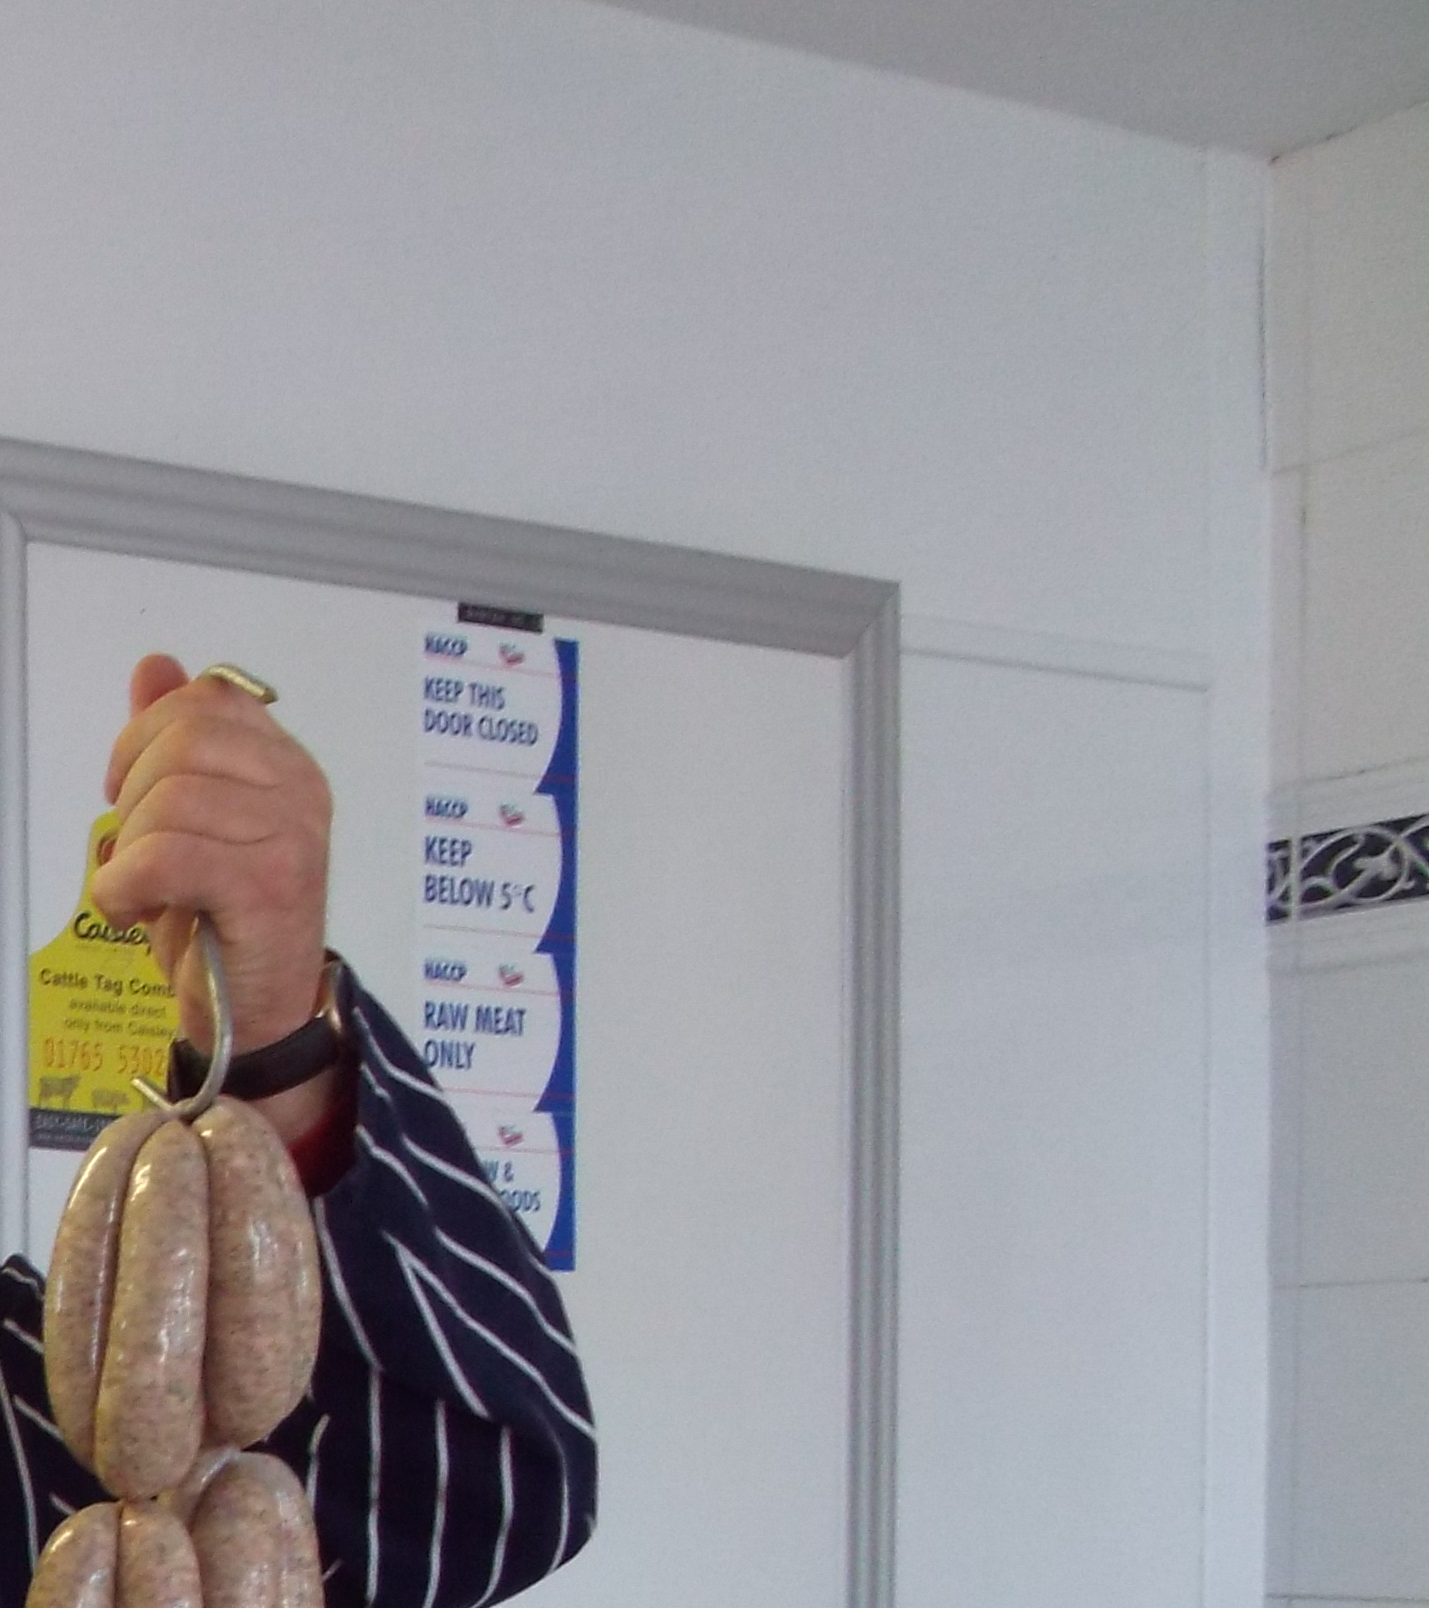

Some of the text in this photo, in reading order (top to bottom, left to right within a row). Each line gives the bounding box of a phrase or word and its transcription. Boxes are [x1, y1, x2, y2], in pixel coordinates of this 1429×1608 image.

[423, 676, 506, 711] KEEP THIS
[424, 709, 539, 747] DOOR CLOSED
[424, 835, 472, 867] KEEP
[424, 874, 495, 908] BELOW
[40, 968, 88, 989] Cattle
[95, 974, 123, 997] Tag
[423, 957, 467, 983] HACCP
[424, 1002, 527, 1036] RAW MEAT
[425, 1039, 474, 1070] ONLY
